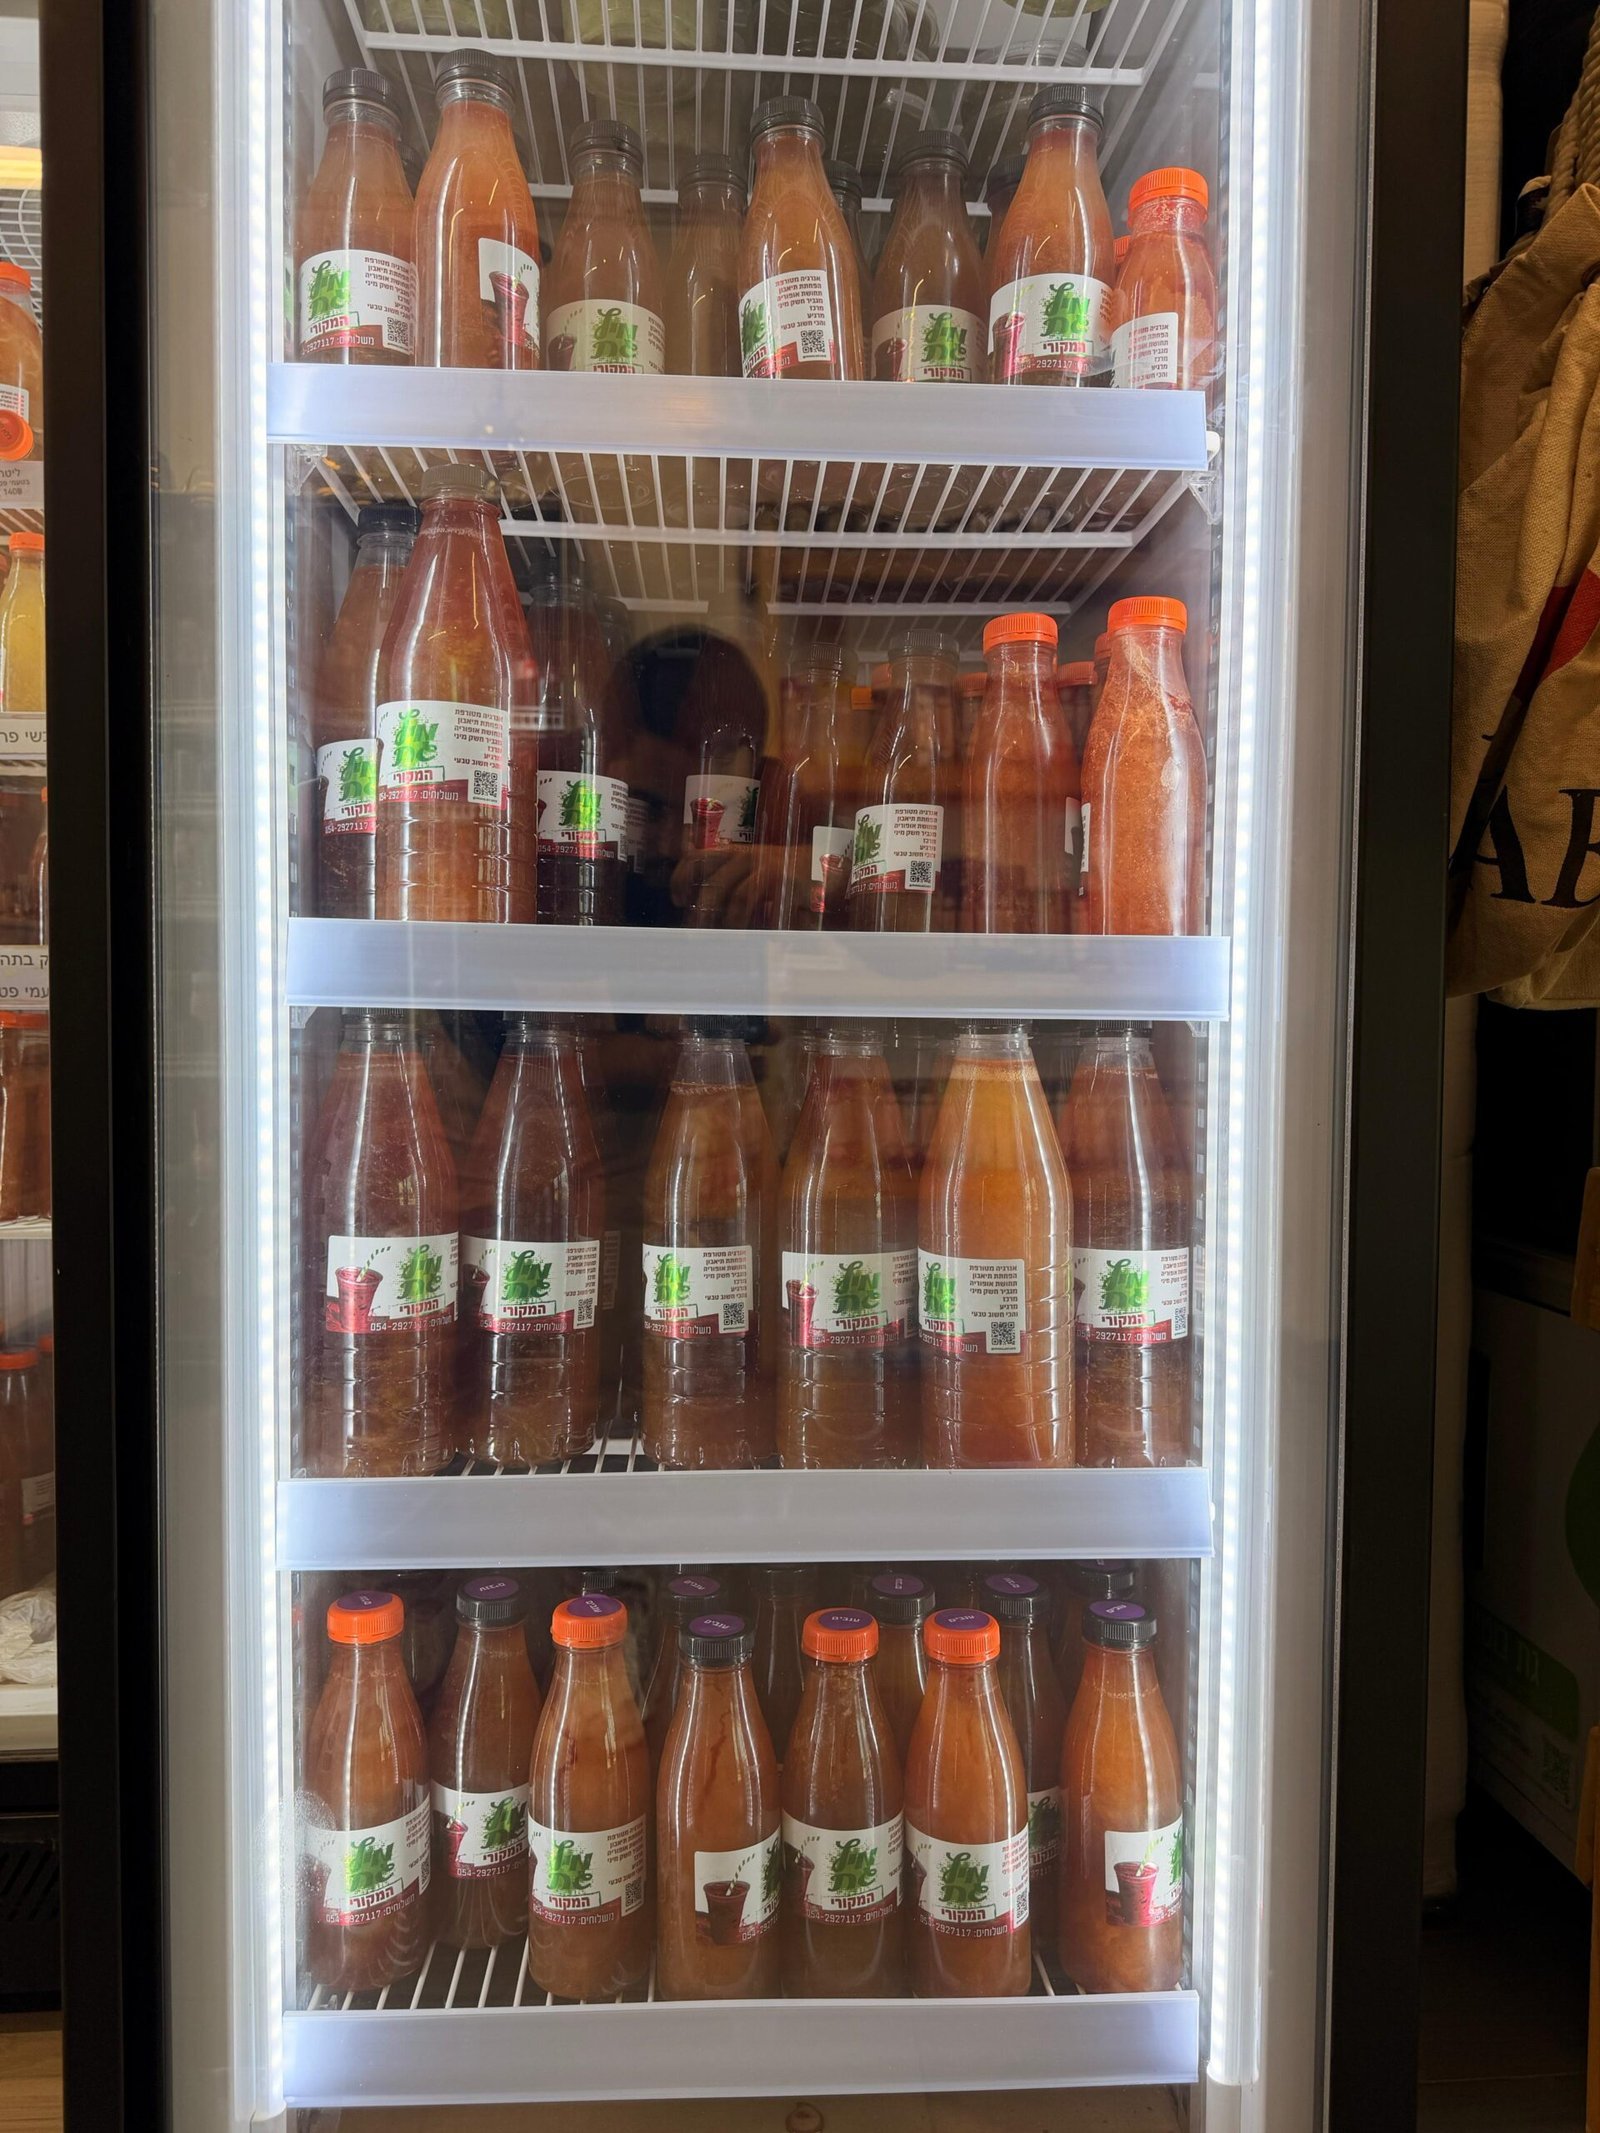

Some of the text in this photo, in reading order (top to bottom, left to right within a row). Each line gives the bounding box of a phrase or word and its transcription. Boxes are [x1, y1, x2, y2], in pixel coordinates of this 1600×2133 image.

[365, 257, 390, 267] מטורפת
[310, 315, 350, 334] המקורי
[1043, 341, 1086, 354] המקורי
[923, 367, 964, 380] המקורי
[455, 709, 481, 718] מטורפת
[420, 790, 459, 801] משלוחים:
[400, 1300, 438, 1315] המקורי
[503, 1304, 546, 1318] המקורי
[836, 1315, 878, 1331] המקורי
[1102, 1314, 1146, 1328] המקורי
[483, 1842, 523, 1862] המקורי
[350, 1886, 394, 1908] המקורי
[549, 1896, 590, 1910] המקורי
[831, 1892, 874, 1910] המקורי
[579, 1912, 615, 1925] משלוחים:
[941, 1908, 986, 1923] המקורי
[973, 1925, 1008, 1938] משלוחים:
